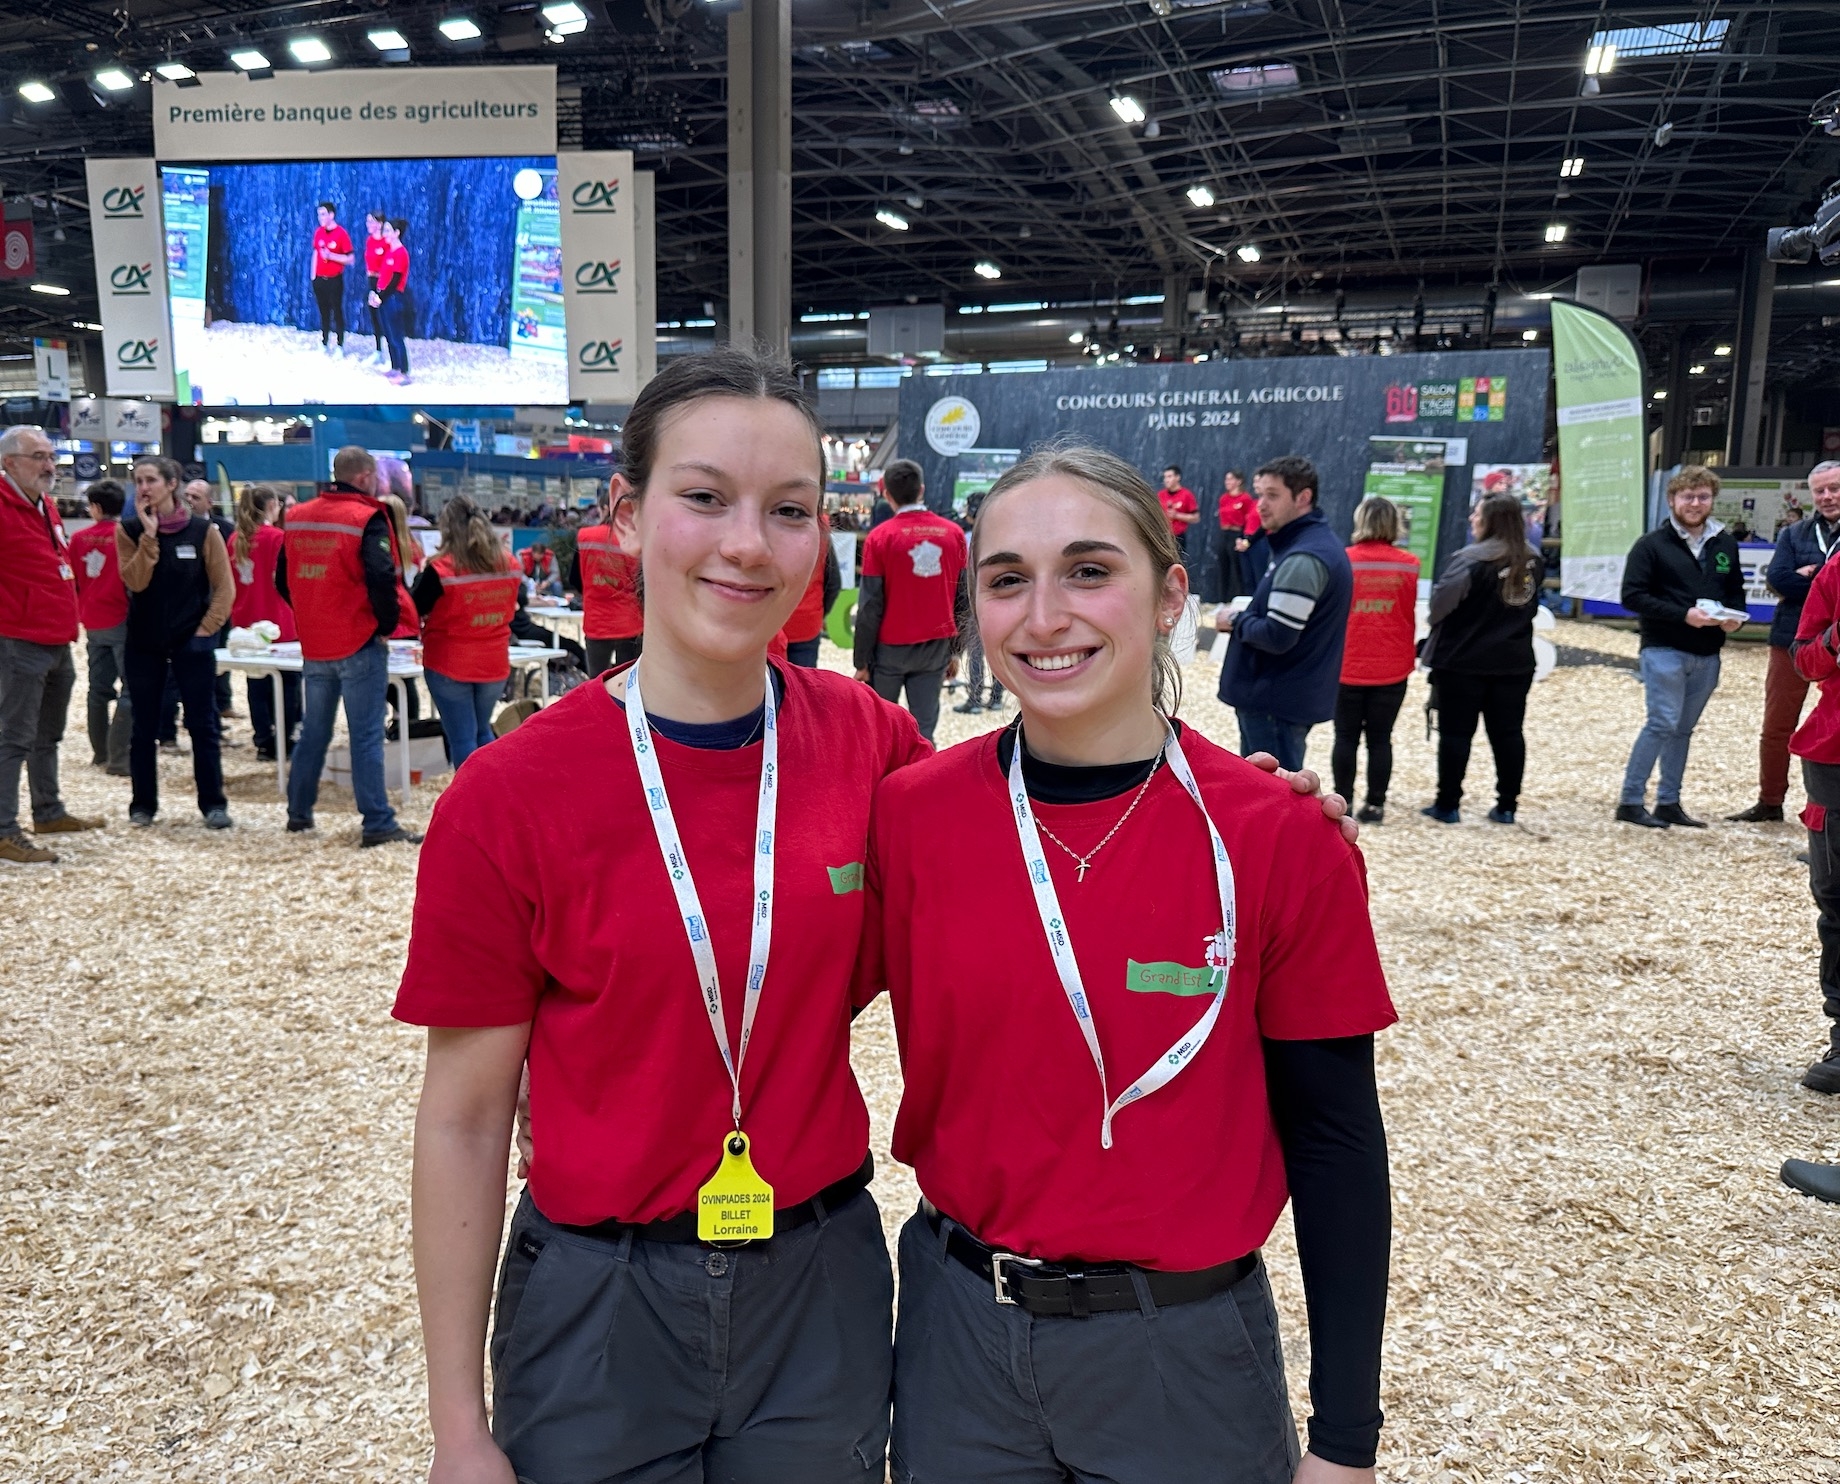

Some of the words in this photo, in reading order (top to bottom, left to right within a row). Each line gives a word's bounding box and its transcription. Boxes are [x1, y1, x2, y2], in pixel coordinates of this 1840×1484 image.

[169, 102, 266, 124] Première
[272, 103, 353, 125] banque
[359, 101, 398, 121] des
[404, 100, 539, 125] agriculteurs
[47, 355, 61, 381] L
[1056, 392, 1156, 411] CONCOURS
[1158, 388, 1243, 407] GENERAL
[1246, 384, 1345, 404] AGRICOLE
[1420, 384, 1457, 396] SALON
[1148, 408, 1196, 432] PARIS
[1200, 410, 1242, 427] 2024
[1353, 599, 1396, 614] JURY
[635, 727, 644, 743] MSD
[1019, 803, 1027, 819] MSD
[669, 852, 679, 869] MSD
[760, 902, 768, 919] MSD
[685, 915, 704, 942] Allflex
[1055, 930, 1065, 947] MSD
[1219, 958, 1225, 967] 1
[751, 964, 765, 990] Allflex
[1140, 969, 1181, 985] Grand
[1183, 972, 1203, 988] Est
[706, 986, 716, 1003] MSD
[1072, 992, 1090, 1019] Allflex
[1176, 1042, 1192, 1056] MSD
[701, 1194, 751, 1205] OVINPIADES
[752, 1193, 771, 1204] 2024
[721, 1210, 751, 1221] BILLET
[713, 1224, 759, 1236] Lorraine
